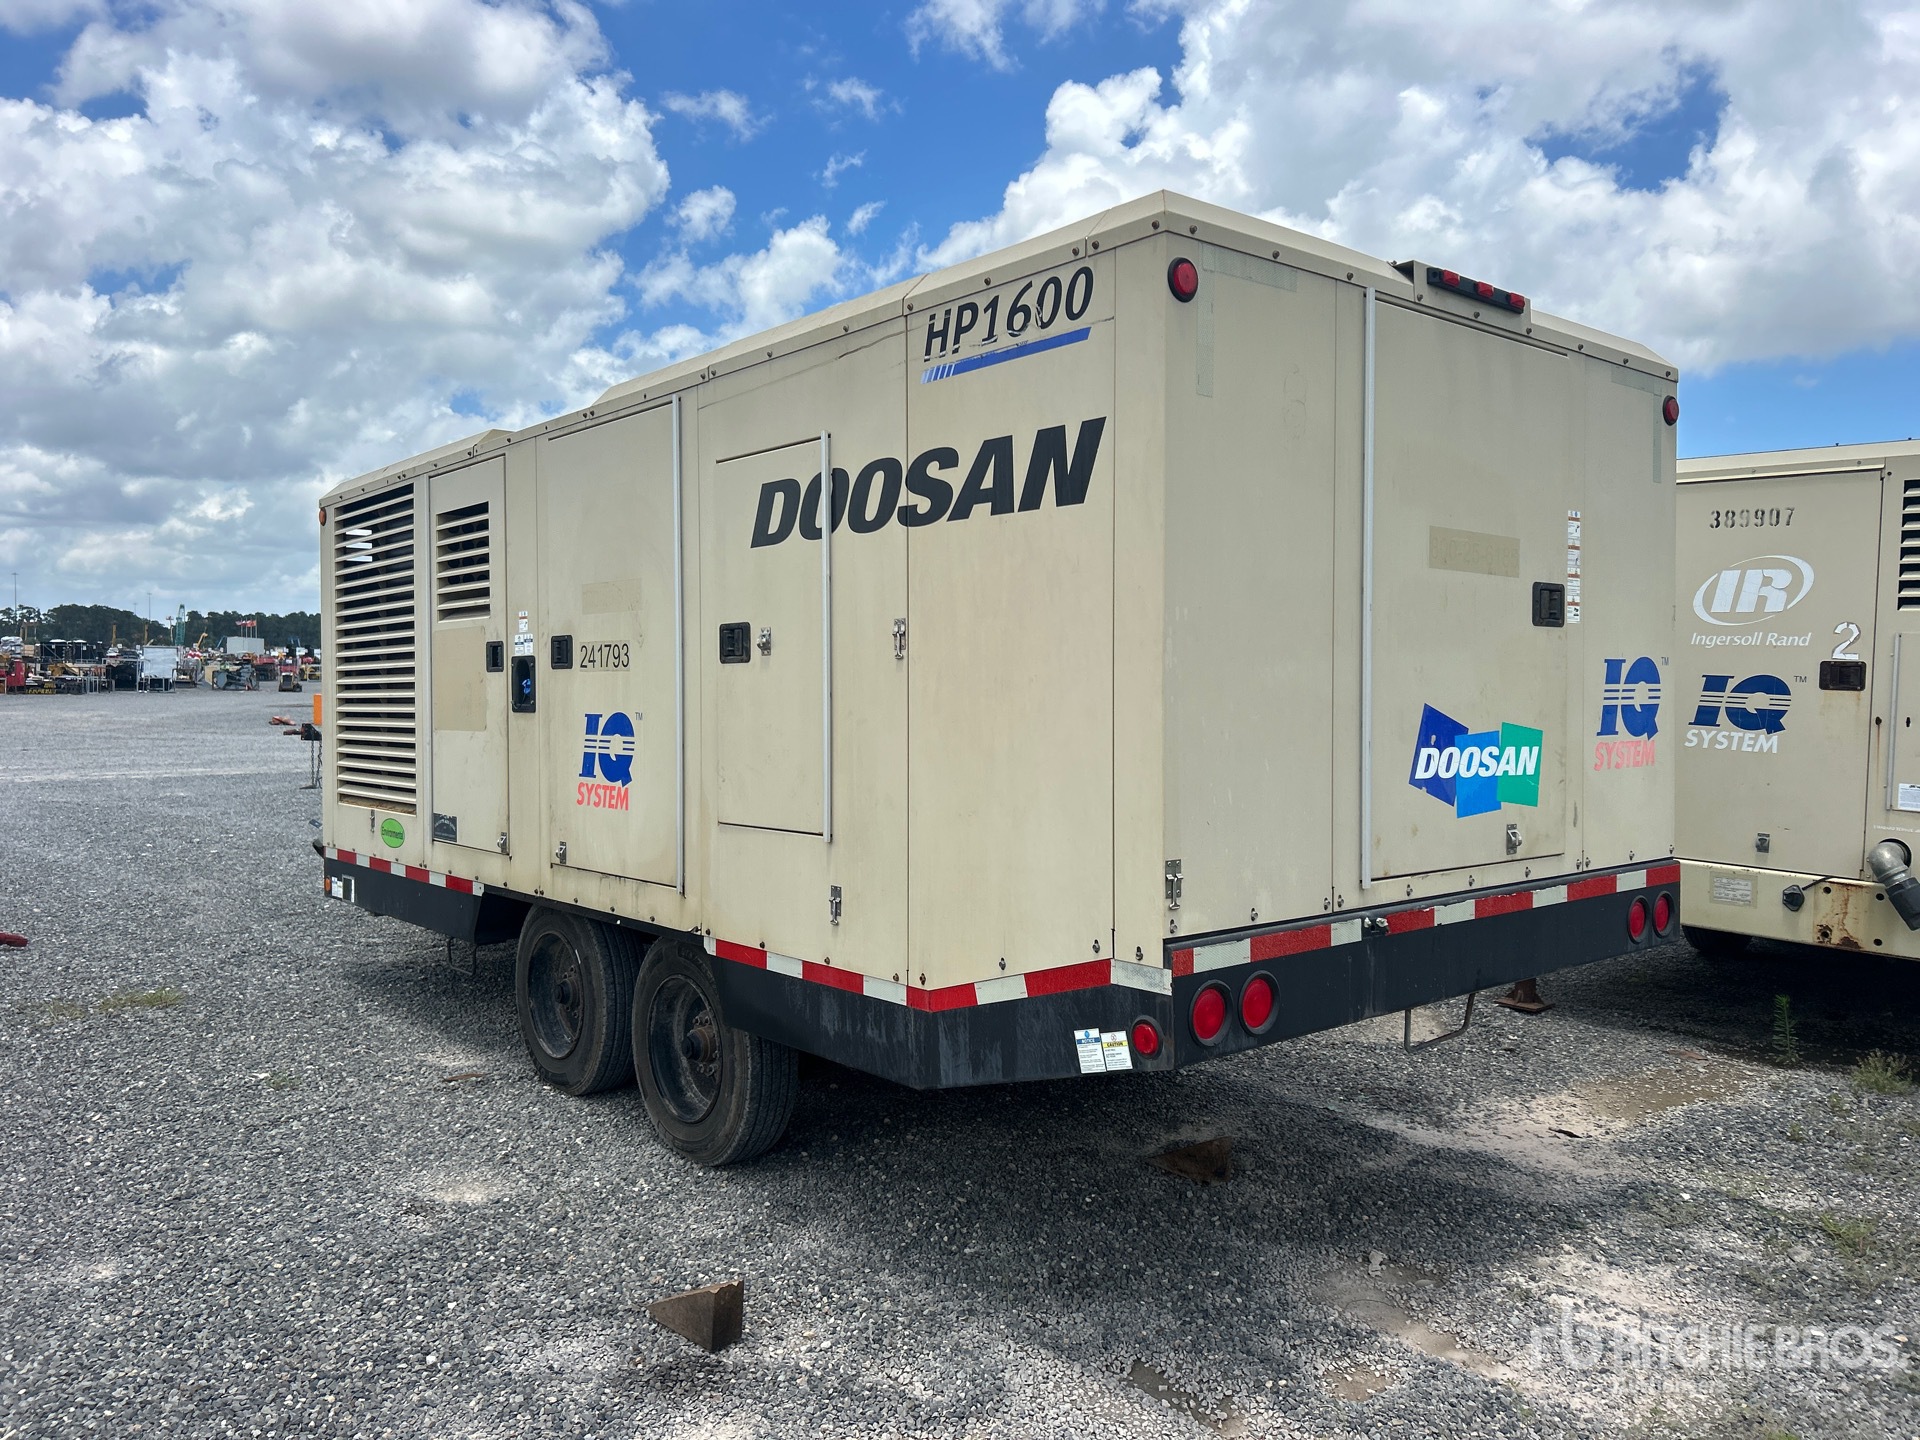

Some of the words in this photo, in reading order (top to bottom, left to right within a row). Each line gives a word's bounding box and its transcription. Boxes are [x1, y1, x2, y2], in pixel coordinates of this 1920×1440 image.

[924, 265, 1094, 363] HP1600
[750, 416, 1107, 549] DOOSAN
[1709, 506, 1795, 529] 389907
[1711, 568, 1793, 613] IR
[579, 643, 630, 669] 241793
[1691, 631, 1763, 649] Ingersoll
[1766, 631, 1813, 647] Rand
[1831, 620, 1861, 661] 2
[1596, 656, 1661, 740] IQ
[1687, 674, 1792, 735] IQ
[579, 711, 636, 787] IQ
[1594, 740, 1656, 771] SYSTEM
[1684, 728, 1779, 754] SYSTEM
[1415, 745, 1540, 780] DOOSAN
[576, 781, 630, 812] SYSTEM
